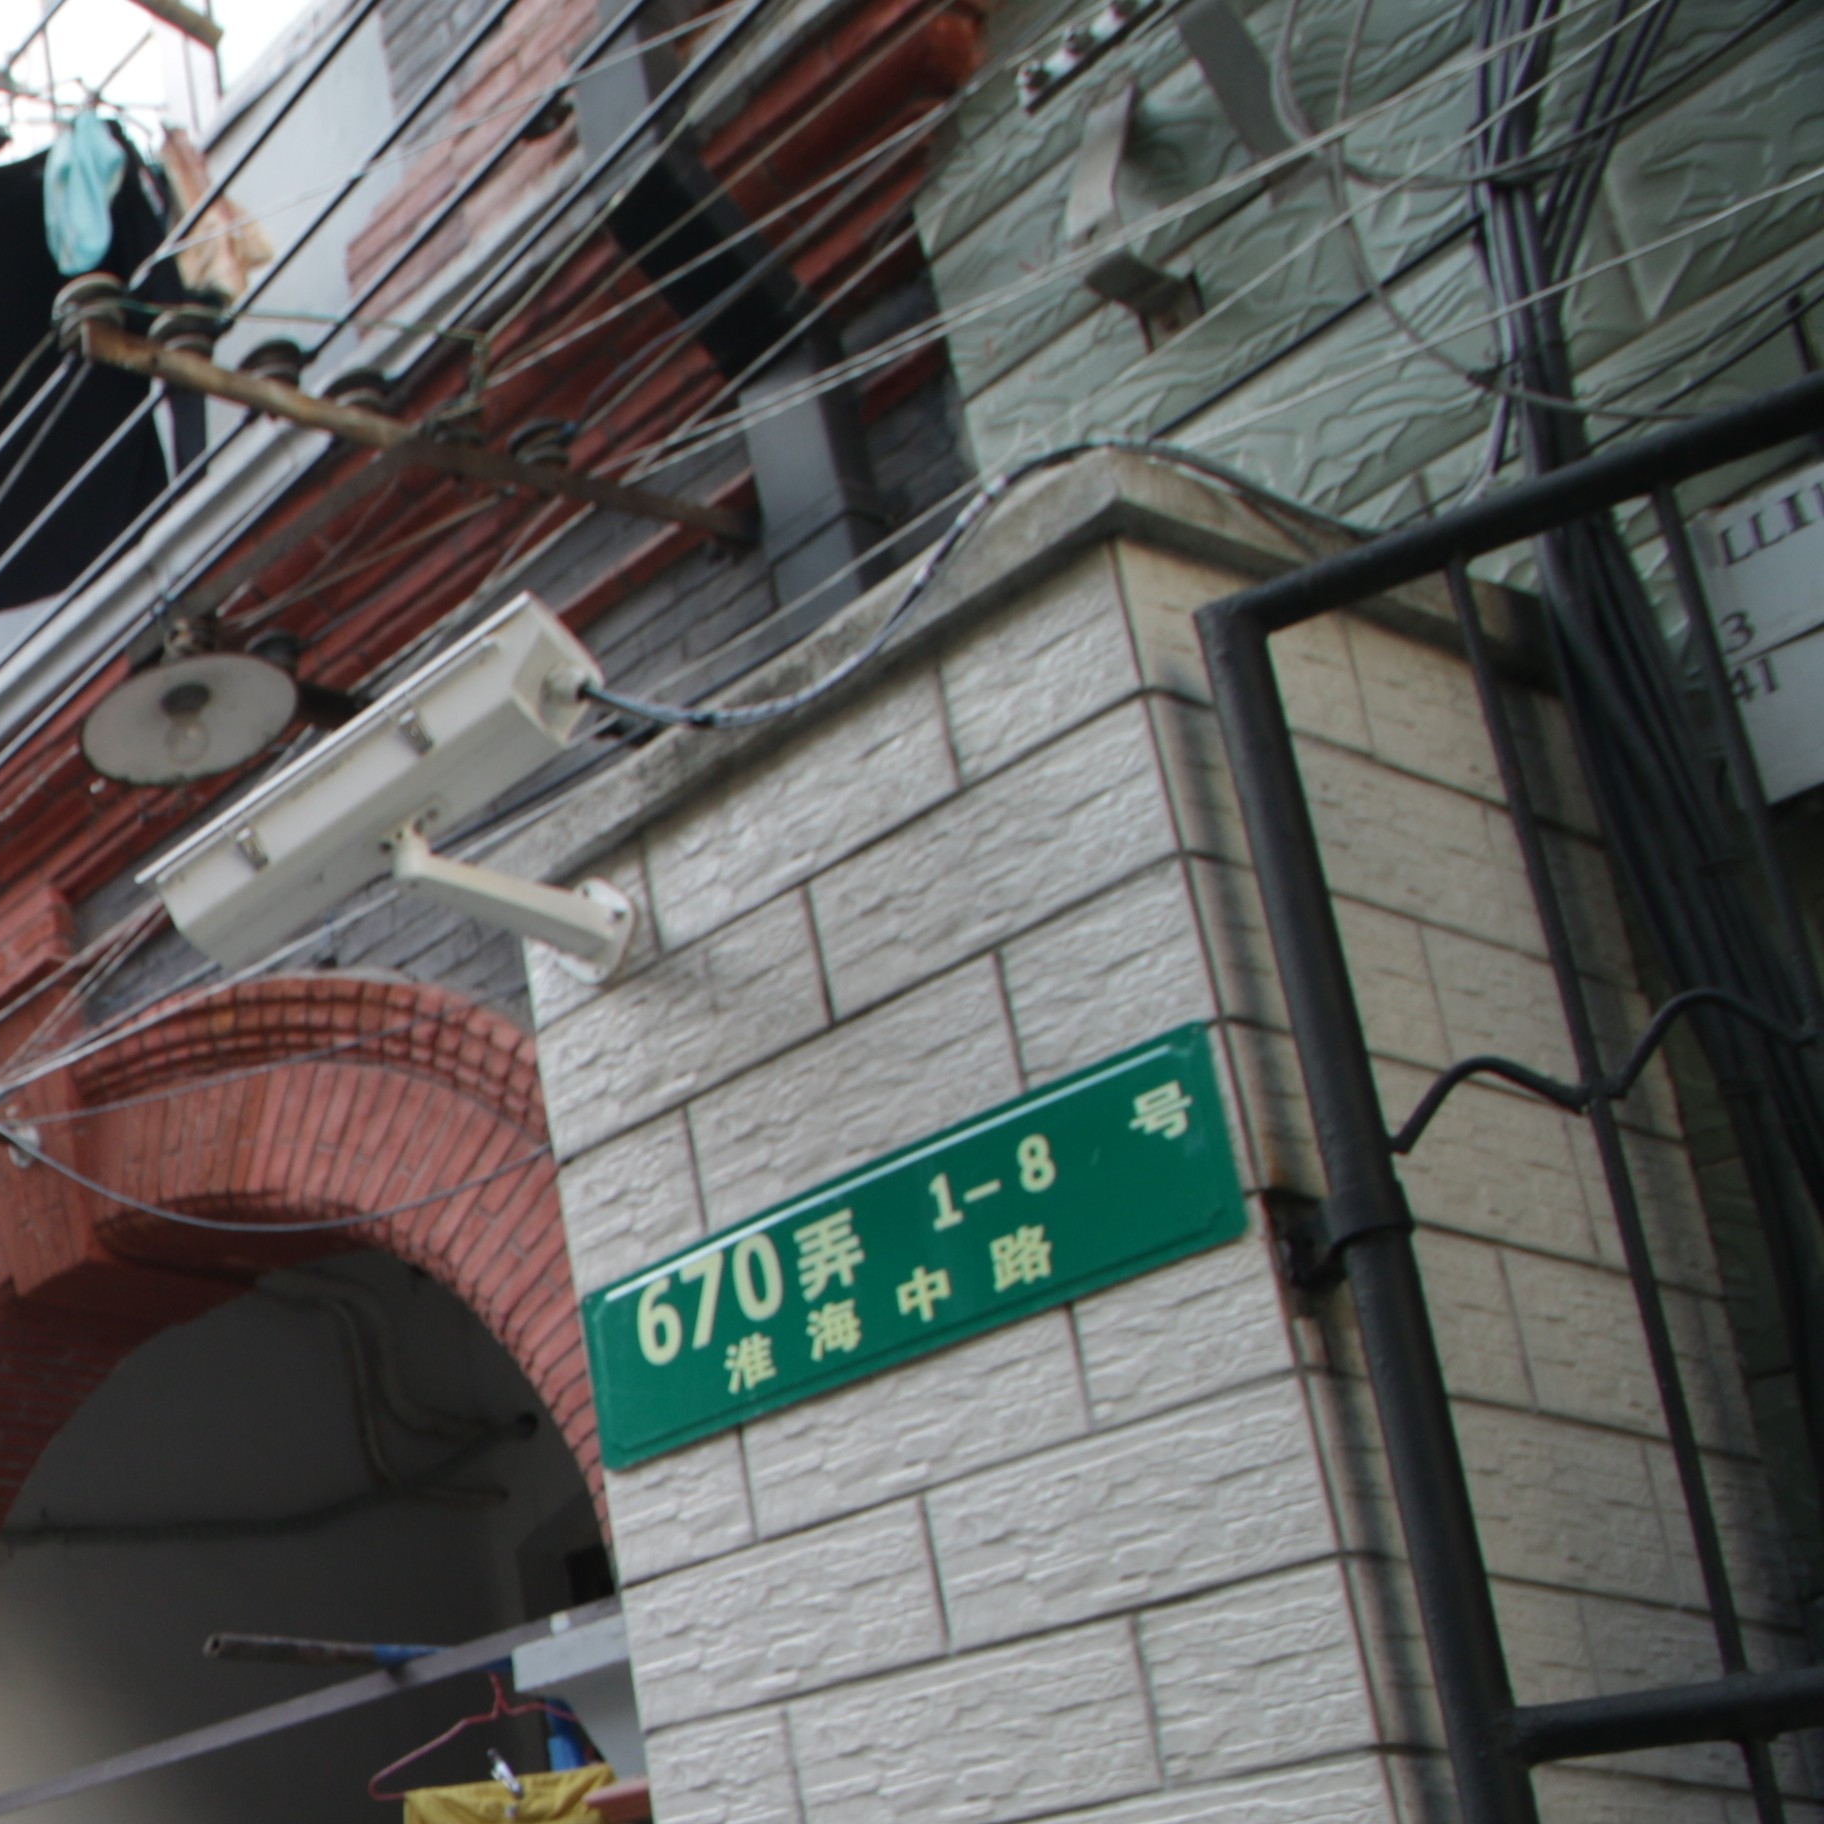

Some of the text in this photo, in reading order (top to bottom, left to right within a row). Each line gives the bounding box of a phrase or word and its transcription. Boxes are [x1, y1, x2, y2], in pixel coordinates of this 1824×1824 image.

[637, 1081, 1192, 1366] 670弄 1-8 号
[725, 1225, 1053, 1394] 淮海中路
